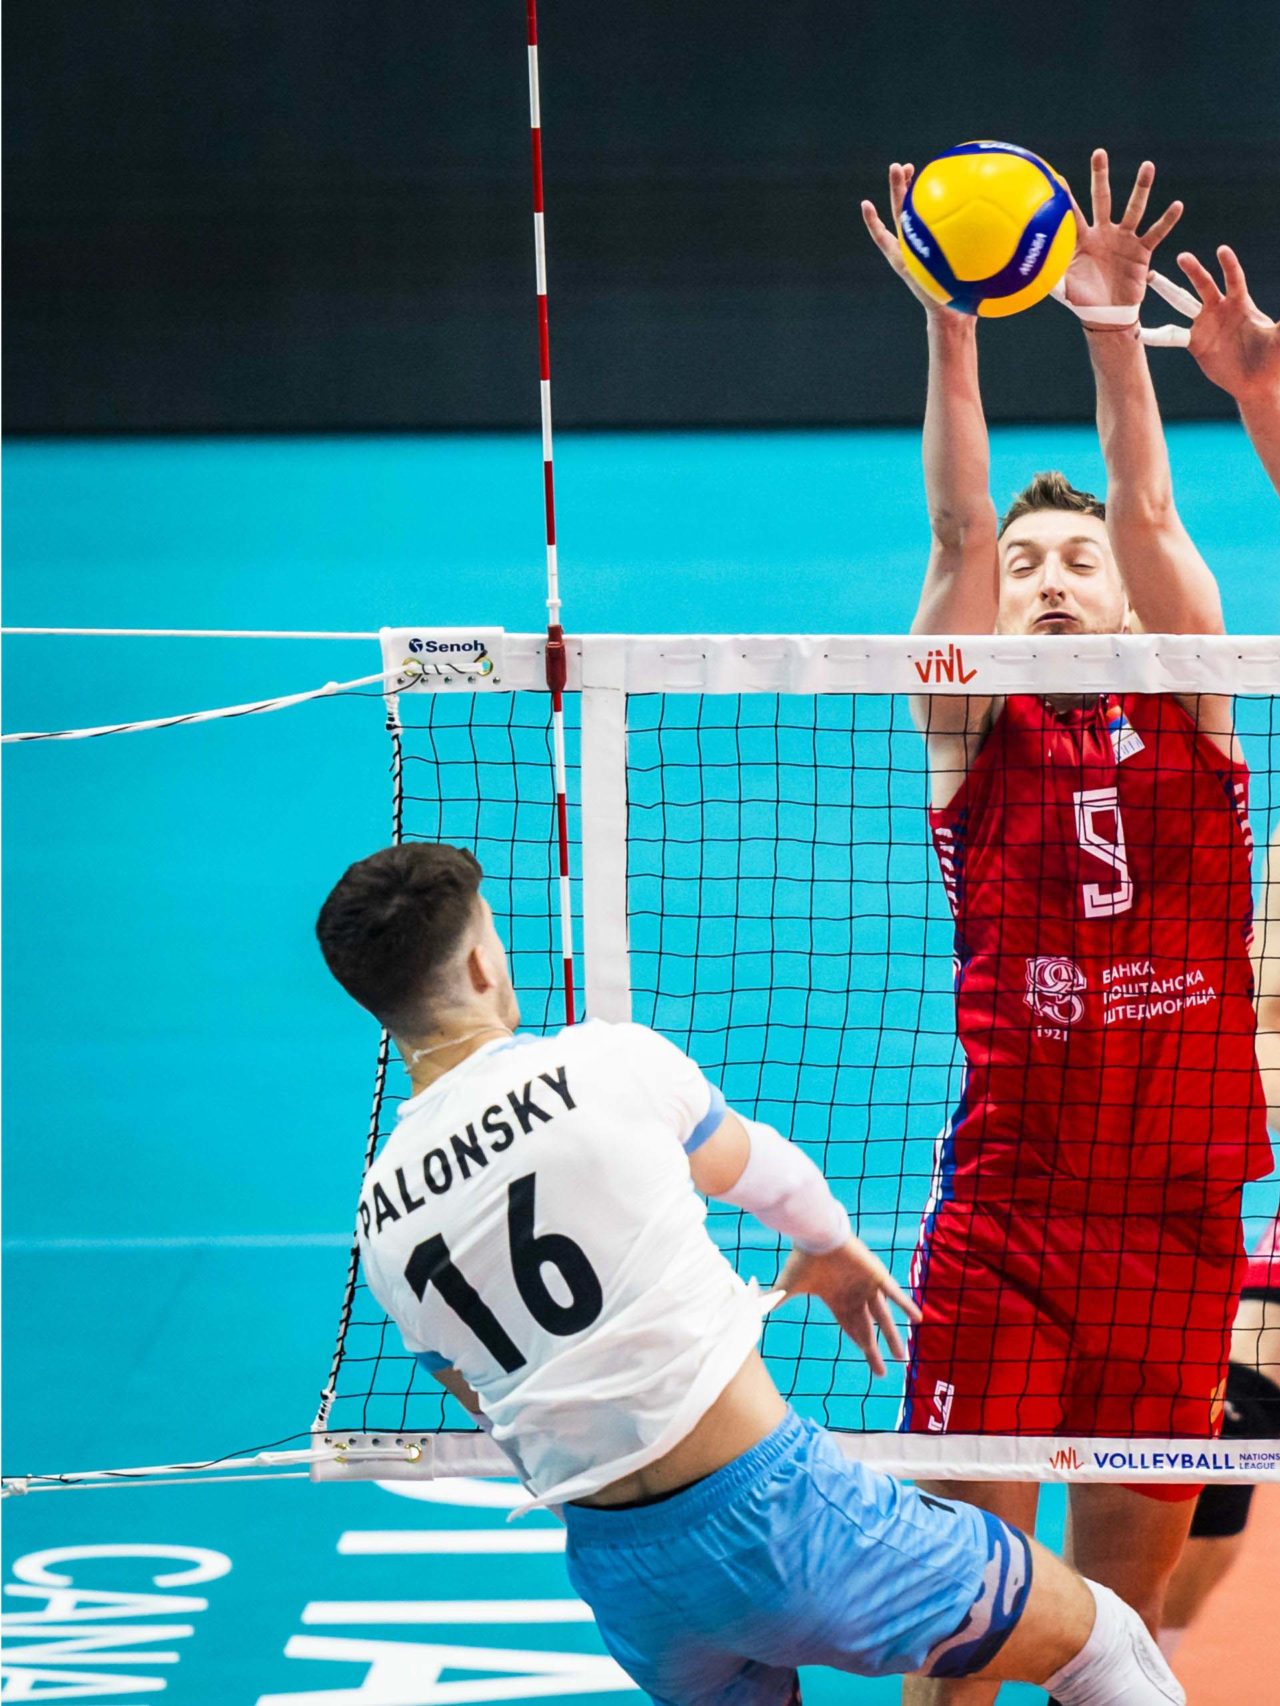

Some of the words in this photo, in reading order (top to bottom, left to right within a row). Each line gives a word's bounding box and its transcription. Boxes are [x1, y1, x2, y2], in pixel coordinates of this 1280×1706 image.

[426, 640, 485, 653] Senoh
[915, 644, 977, 684] VNL
[1073, 787, 1133, 918] 9
[1103, 961, 1155, 984] БАНКА
[1103, 969, 1205, 1005] ПОШТАНСКА
[1103, 986, 1216, 1025] ШТЕДИОНИЦА
[1037, 1025, 1068, 1041] 1921
[357, 1065, 577, 1240] PALONSKY
[404, 1172, 603, 1374] 16
[1050, 1446, 1084, 1471] VNL
[1093, 1452, 1236, 1470] VOLLEYBALL
[1239, 1453, 1280, 1461] NATIONS
[1239, 1462, 1276, 1470] LEAGUE
[1, 1543, 233, 1706] CANA
